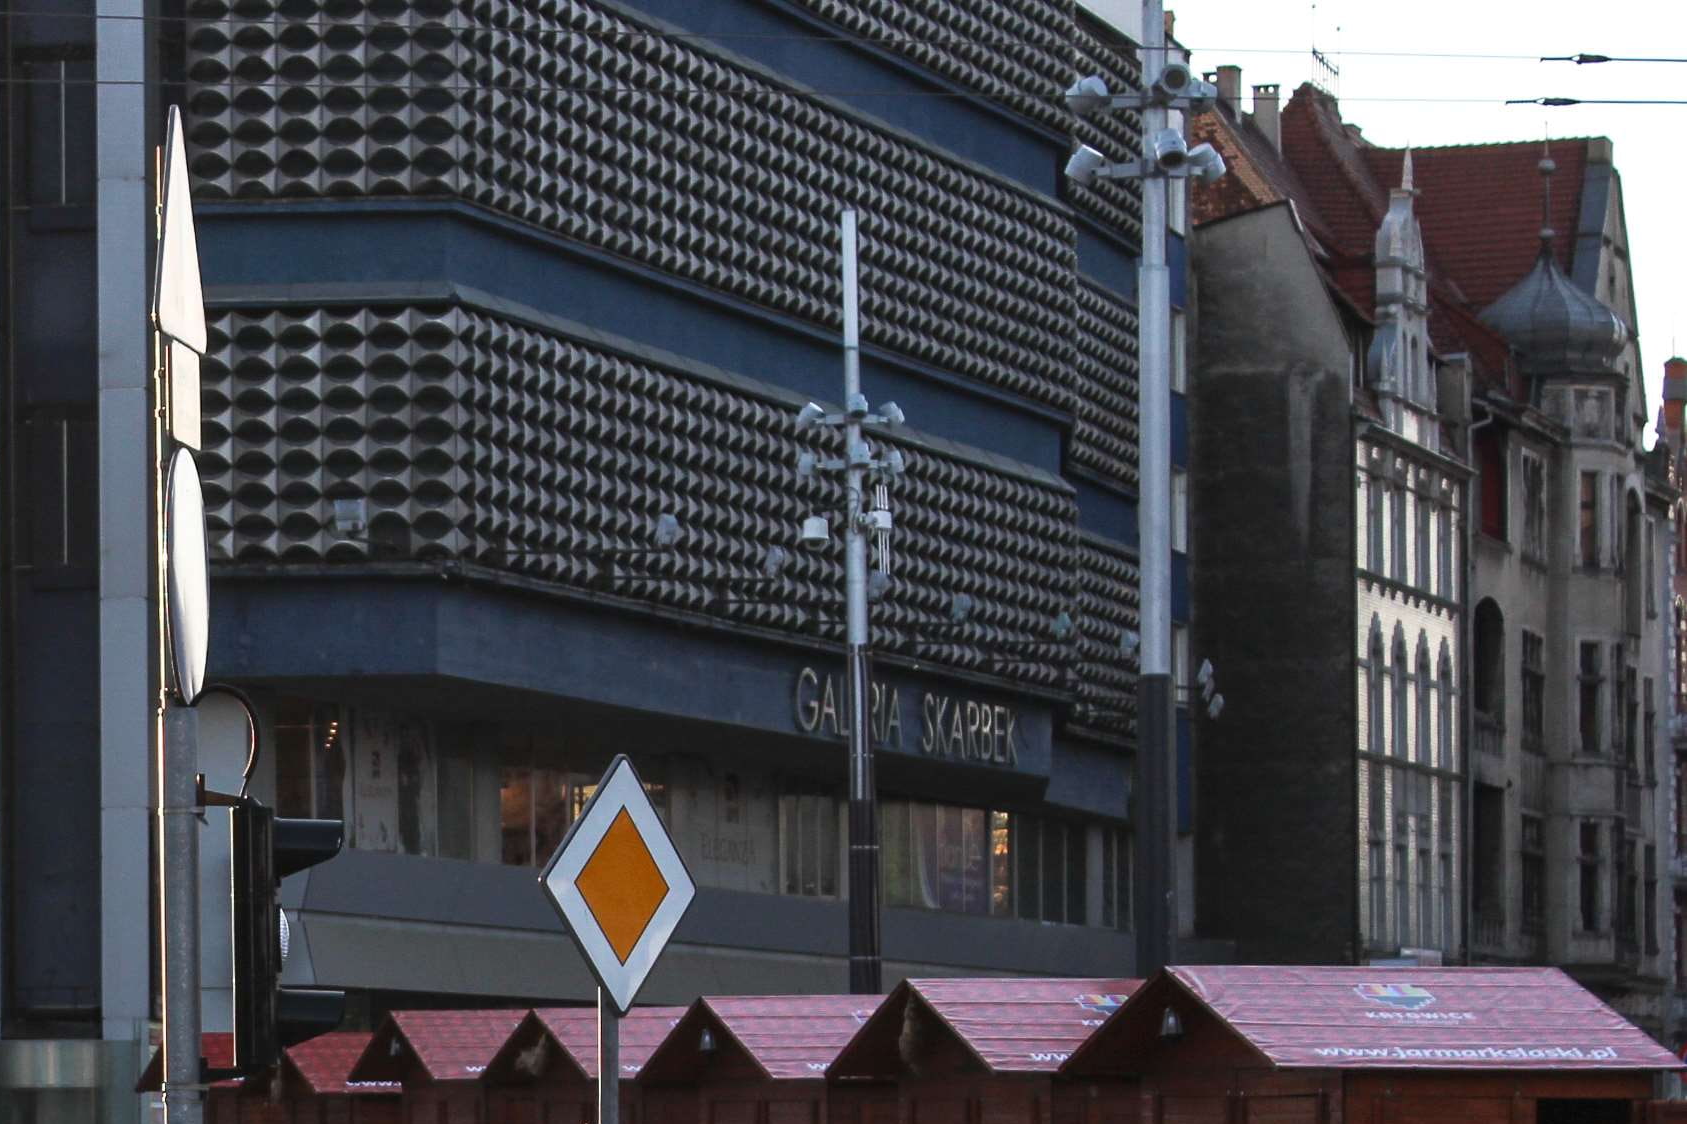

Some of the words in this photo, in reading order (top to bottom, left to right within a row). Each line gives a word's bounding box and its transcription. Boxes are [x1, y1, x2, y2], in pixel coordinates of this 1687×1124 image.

[796, 666, 903, 748] GALRIA
[921, 692, 1018, 765] SKARBEK
[1315, 1046, 1618, 1060] www.jarmarkslaski.pl
